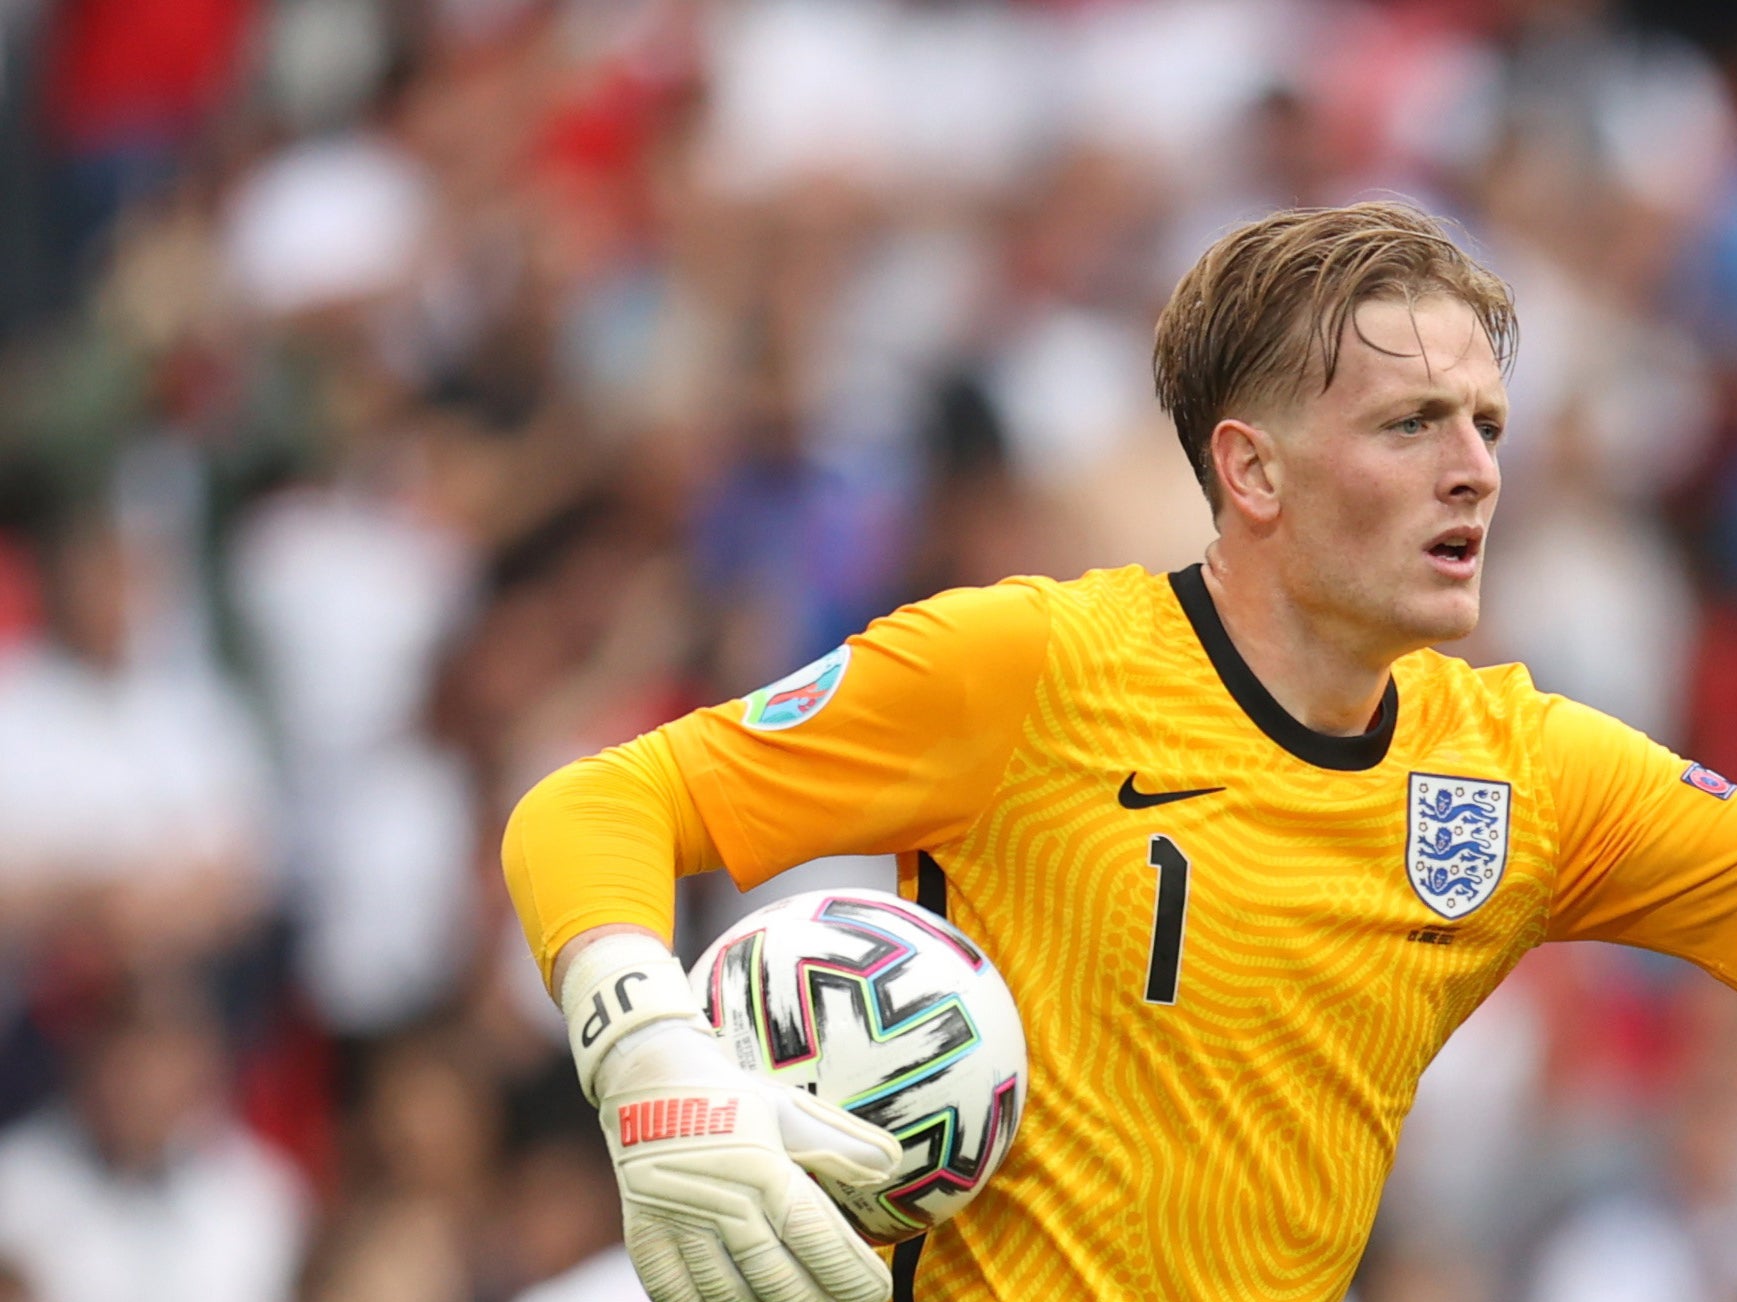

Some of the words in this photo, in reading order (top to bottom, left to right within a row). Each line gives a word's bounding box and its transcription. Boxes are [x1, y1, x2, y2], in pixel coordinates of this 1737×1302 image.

[1143, 834, 1190, 1005] 1
[582, 971, 649, 1048] JP
[618, 1098, 738, 1149] PUMA
